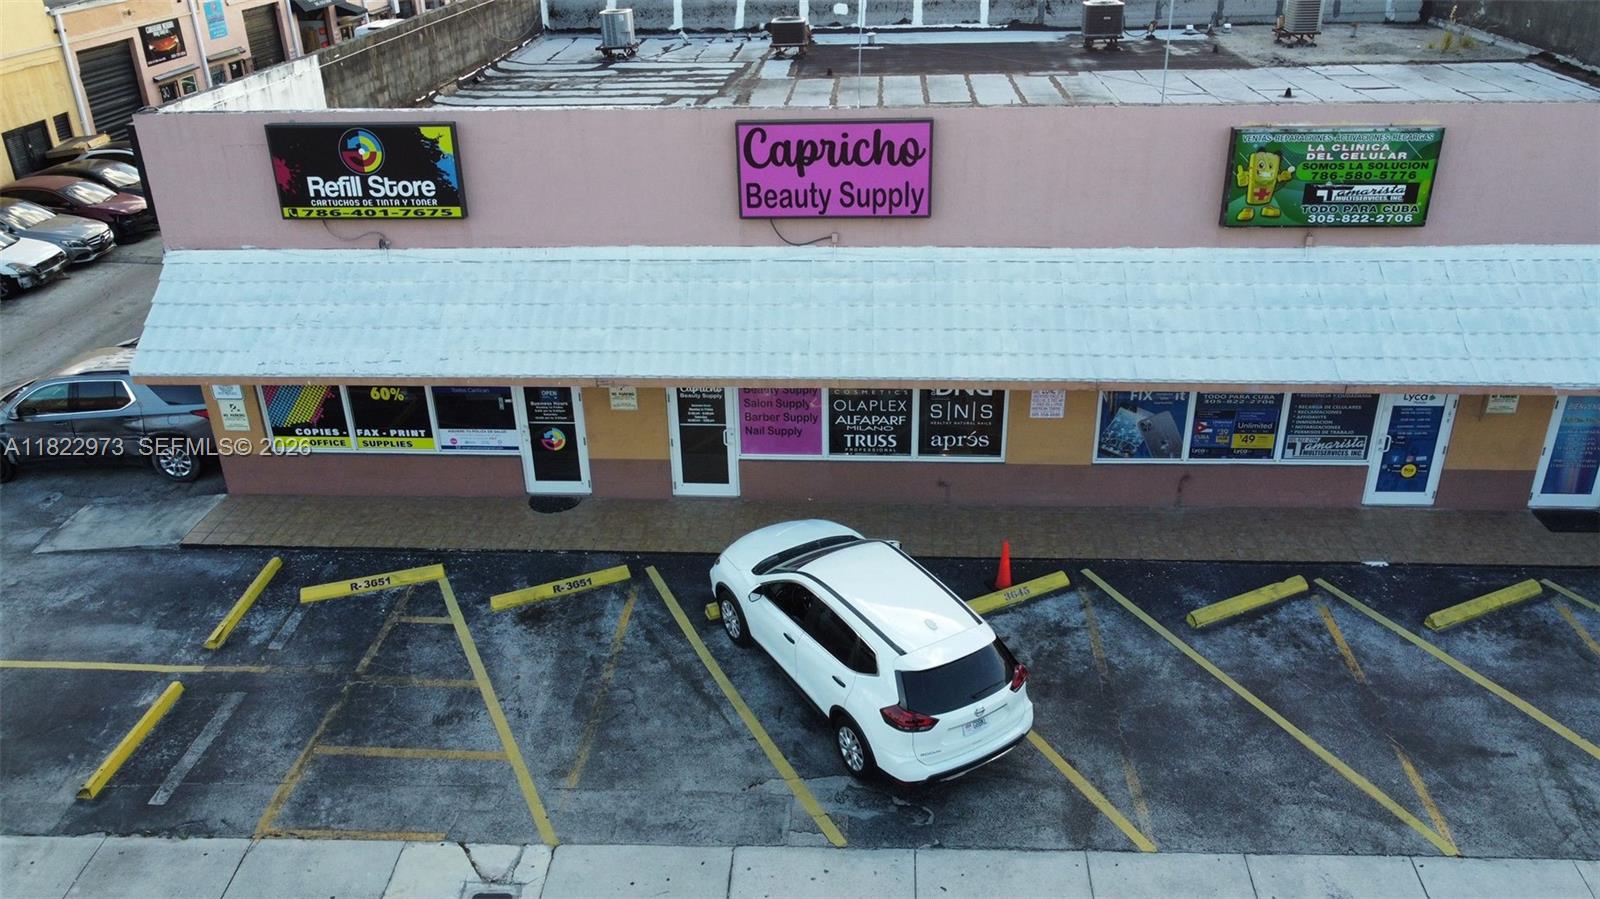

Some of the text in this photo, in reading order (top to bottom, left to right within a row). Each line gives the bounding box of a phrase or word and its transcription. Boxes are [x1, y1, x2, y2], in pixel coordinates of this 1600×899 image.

[744, 127, 926, 178] Capricho
[1368, 162, 1430, 170] SOLUCION
[1311, 171, 1417, 180] 786-580-5776
[306, 175, 436, 197] Refill Store
[746, 181, 924, 214] Beauty Supply
[302, 208, 453, 217] 786-401-7675
[1302, 204, 1418, 213] TODO PARA CUBA
[1308, 214, 1413, 223] 305-822-2706
[370, 387, 404, 400] 60%
[744, 399, 810, 410] Salon Supply
[834, 400, 907, 412] OLAPLEX
[745, 412, 818, 424] Barber Supply
[835, 415, 906, 425] ALFAPARF
[295, 428, 339, 436] COPIES
[390, 429, 426, 437] PRINT
[745, 426, 802, 437] Nail Supply
[844, 434, 897, 447] TRUSS
[1004, 586, 1030, 601] 3645
